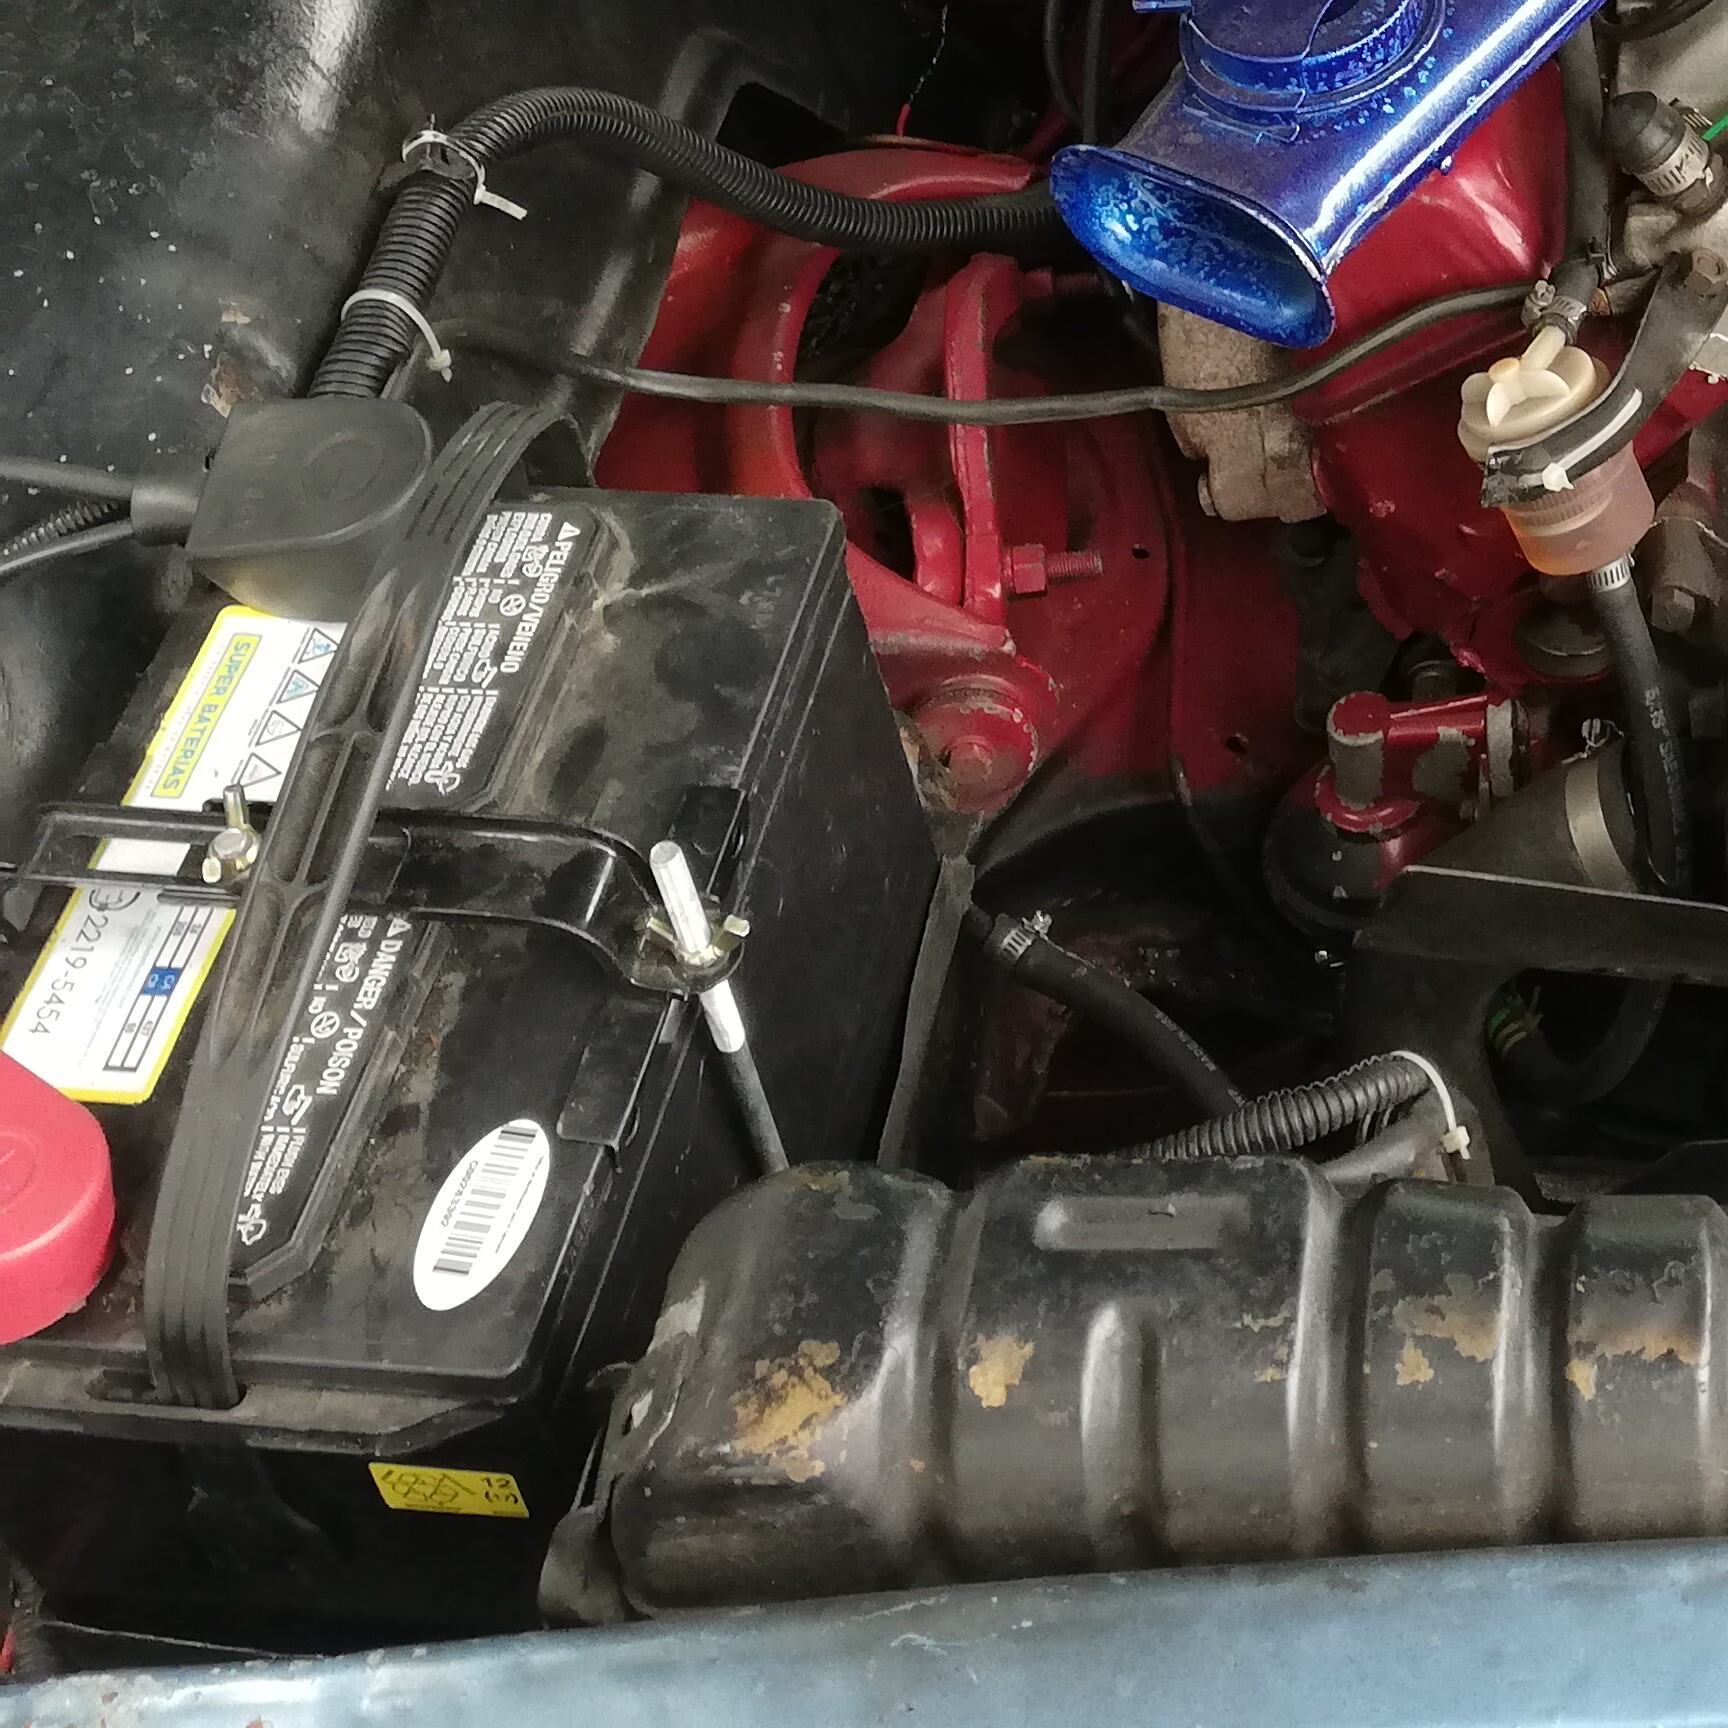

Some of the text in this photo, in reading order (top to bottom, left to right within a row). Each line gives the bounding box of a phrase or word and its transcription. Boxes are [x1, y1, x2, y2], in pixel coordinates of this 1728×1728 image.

[210, 641, 251, 697] SUPER
[162, 703, 220, 791] BATERIAS
[28, 914, 109, 1035] 2219-5454
[353, 940, 403, 1010] DANGER
[316, 1026, 364, 1095] POISON
